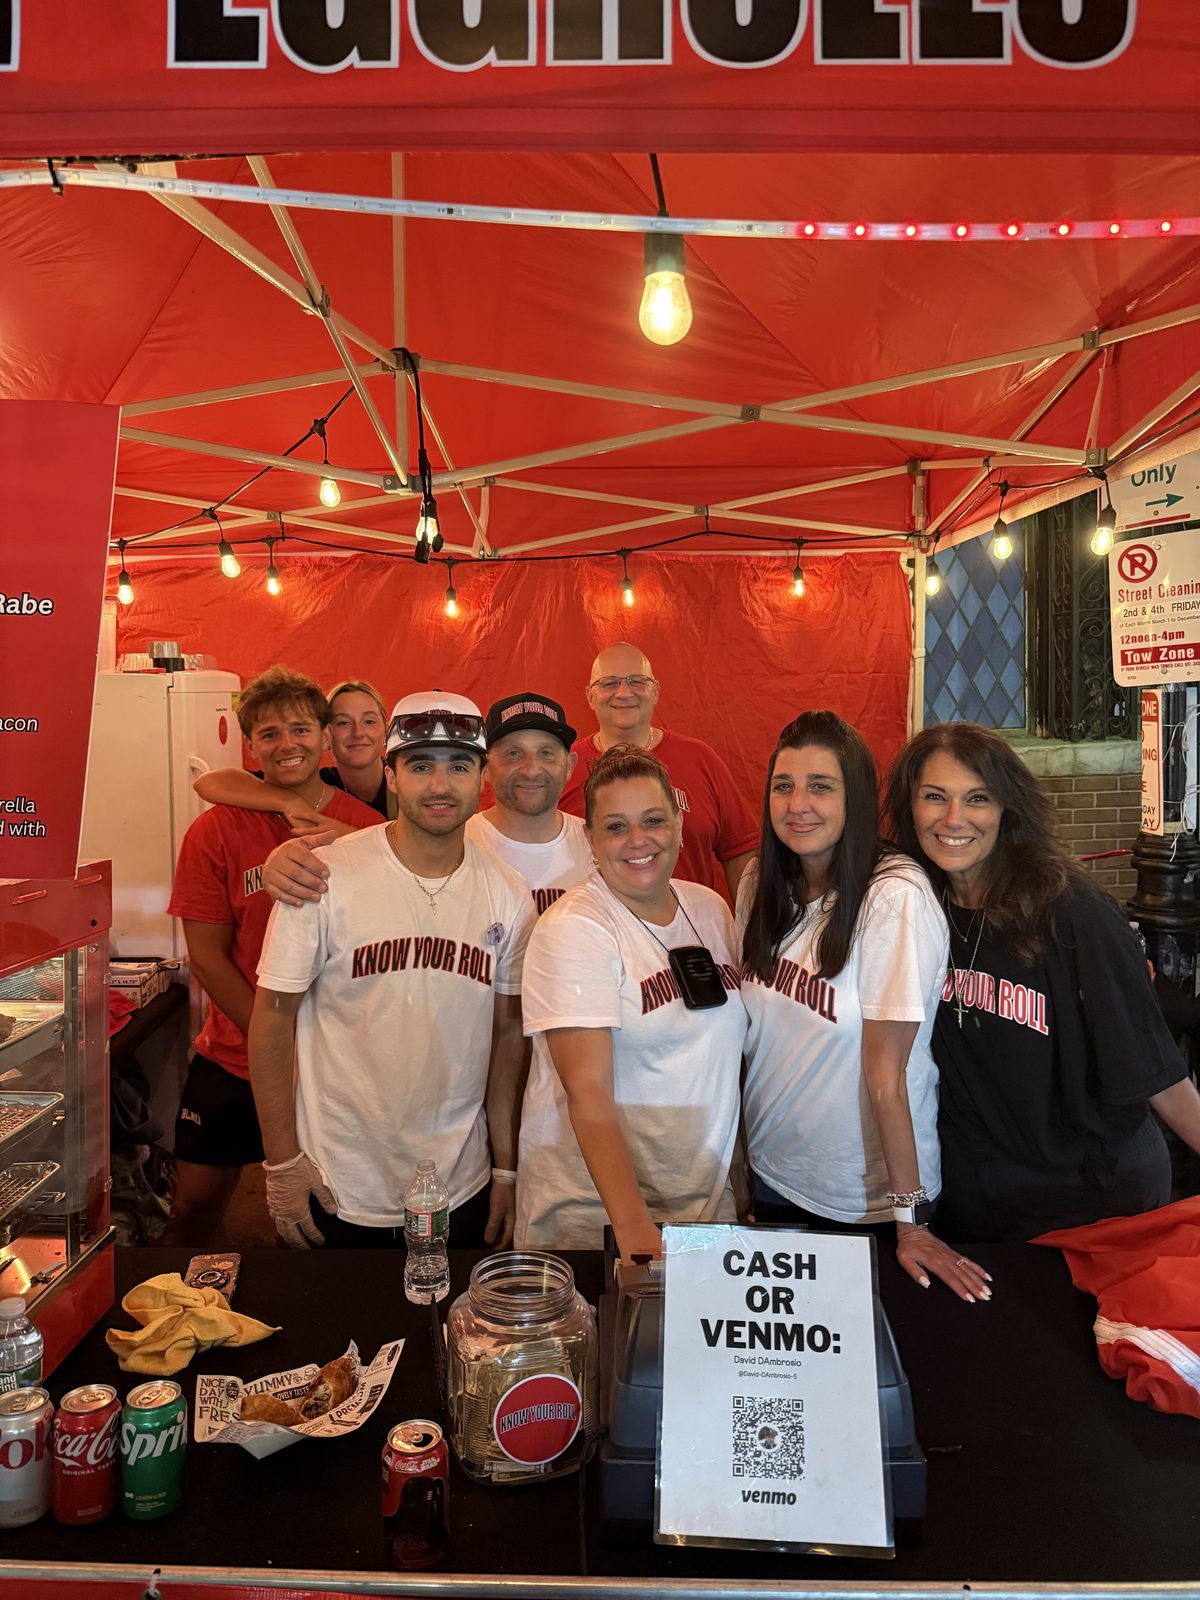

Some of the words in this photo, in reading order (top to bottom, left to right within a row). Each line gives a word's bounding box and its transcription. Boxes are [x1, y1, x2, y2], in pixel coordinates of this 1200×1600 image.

[1131, 464, 1177, 487] Only
[1118, 583, 1152, 603] Street
[1124, 608, 1138, 618] 2nd
[1142, 607, 1147, 616] &
[1151, 605, 1165, 614] 4th
[1125, 651, 1152, 664] Tow
[1159, 648, 1195, 660] Zone
[8, 820, 46, 837] with
[352, 936, 412, 979] KNOW
[412, 935, 457, 973] YOUR
[457, 942, 492, 987] ROLL
[794, 967, 838, 1025] ROLL
[955, 968, 996, 1014] YOUR
[998, 978, 1049, 1036] ROLL
[723, 1250, 817, 1280] CASH
[745, 1285, 795, 1315] OR
[700, 1318, 841, 1354] VENMO:
[733, 1355, 756, 1365] David
[758, 1356, 802, 1367] DAmbrosio
[199, 1387, 225, 1397] DAY
[200, 1378, 226, 1389] NICE
[243, 1373, 293, 1396] YUMMY
[500, 1408, 529, 1434] KNOW
[530, 1402, 555, 1422] YOUR
[555, 1402, 576, 1420] ROLL
[62, 1468, 96, 1476] ORIGINAL
[741, 1489, 797, 1506] venmo
